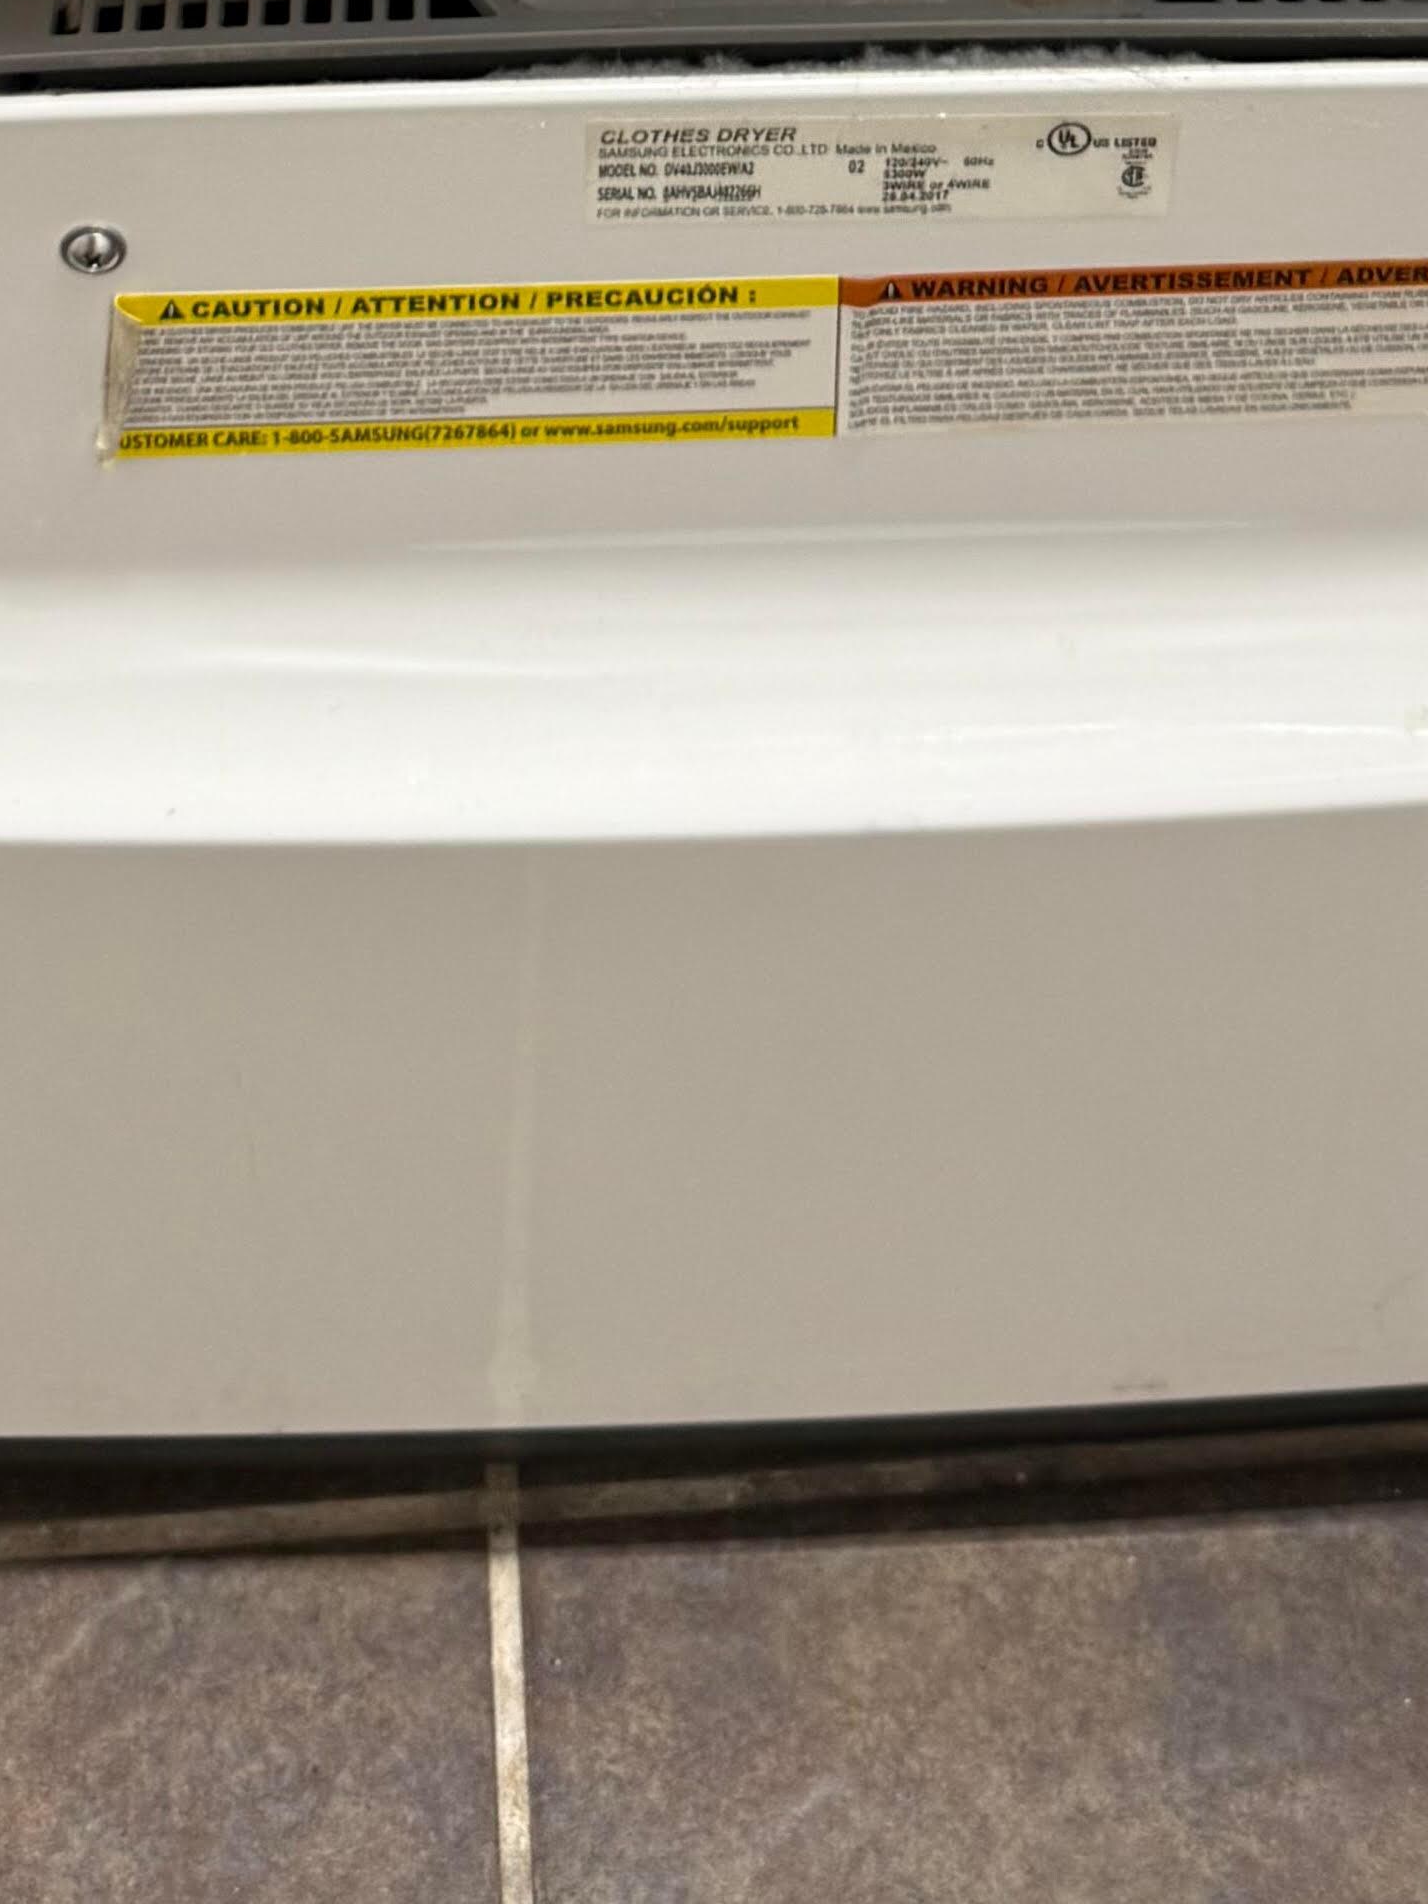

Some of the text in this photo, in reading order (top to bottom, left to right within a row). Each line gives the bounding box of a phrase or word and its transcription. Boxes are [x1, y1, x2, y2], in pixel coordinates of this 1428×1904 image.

[600, 127, 797, 144] CLOTHES DRYER
[1114, 136, 1157, 148] LISTED
[598, 146, 668, 160] SAMSUNG
[672, 145, 770, 158] ELECTRONICS
[835, 143, 871, 155] Made
[891, 143, 937, 155] Mexico
[599, 163, 636, 178] MODEL
[849, 160, 865, 174] 02
[947, 178, 991, 191] 4WIRE
[597, 187, 637, 202] SERIAL
[910, 276, 1049, 299] WARNING
[1058, 274, 1067, 294] /
[1075, 269, 1312, 293] AVERTISSEMENT
[191, 297, 325, 319] CAUTION
[335, 295, 343, 315] /
[351, 292, 520, 316] ATTENTION
[529, 290, 538, 310] /
[547, 284, 739, 309] PRECAUCIÓN
[119, 414, 799, 451] USTOMER CARE: 1-800-SAMSUNG(7267864) or www.samsung.com/support
